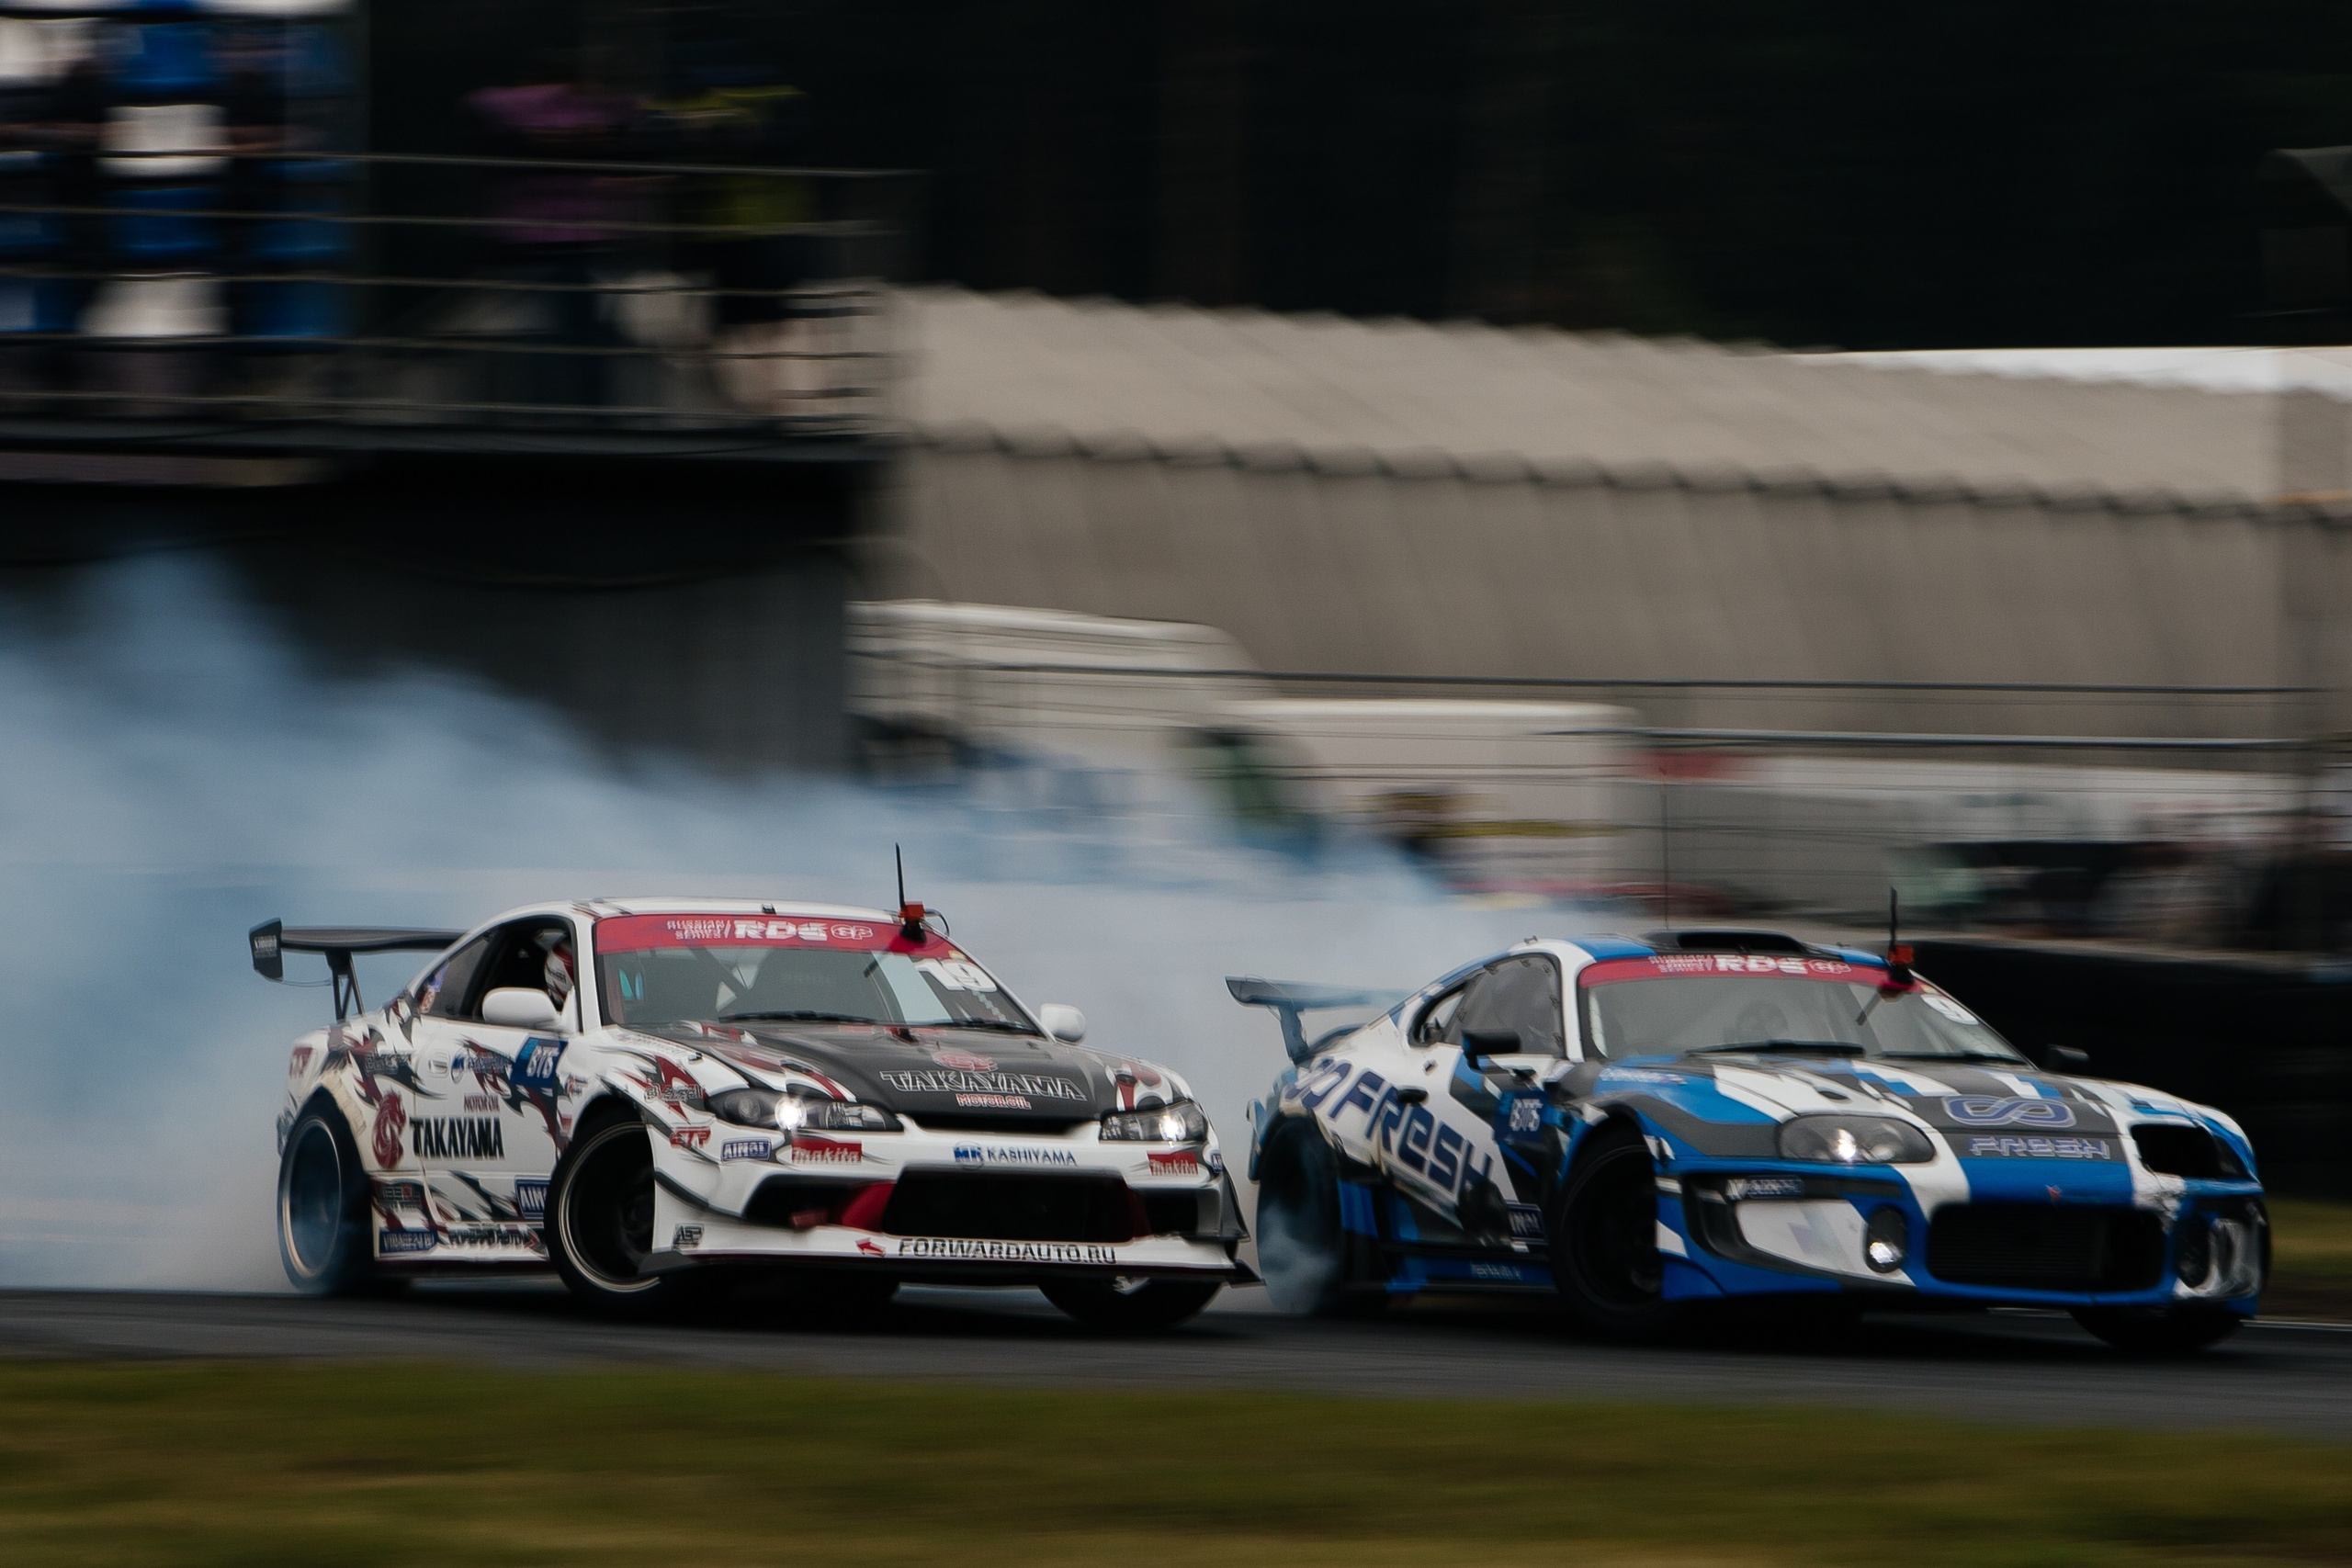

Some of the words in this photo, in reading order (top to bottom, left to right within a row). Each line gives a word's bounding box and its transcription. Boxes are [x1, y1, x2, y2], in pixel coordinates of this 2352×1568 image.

[735, 920, 827, 942] RDS
[913, 958, 997, 992] 19
[1714, 955, 1807, 975] RDS
[879, 1070, 1087, 1101] TAKAYAMA
[956, 1093, 1004, 1108] MOTOR
[1005, 1096, 1032, 1110] OIL
[410, 1115, 504, 1159] TAKAYAMA
[987, 1147, 1079, 1166] KASHIYAMA
[898, 1237, 1117, 1264] FORWARDAUTO.RU
